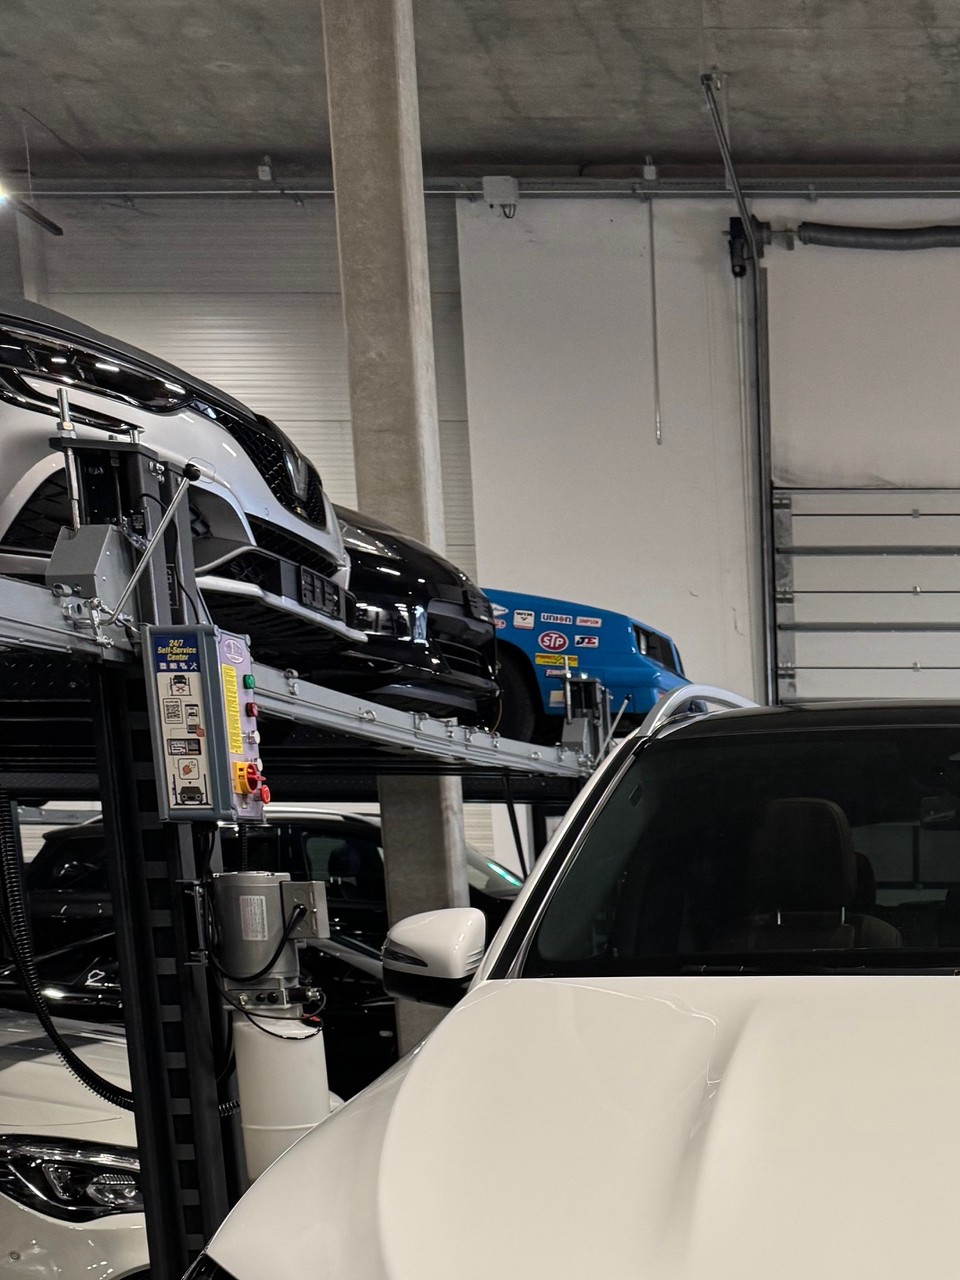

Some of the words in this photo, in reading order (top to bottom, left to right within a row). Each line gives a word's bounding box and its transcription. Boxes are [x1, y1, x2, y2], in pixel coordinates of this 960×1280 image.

[168, 639, 184, 647] 24/7
[542, 633, 565, 648] STP
[575, 636, 597, 646] JE
[157, 646, 197, 654] Self-Service
[167, 653, 189, 661] Center
